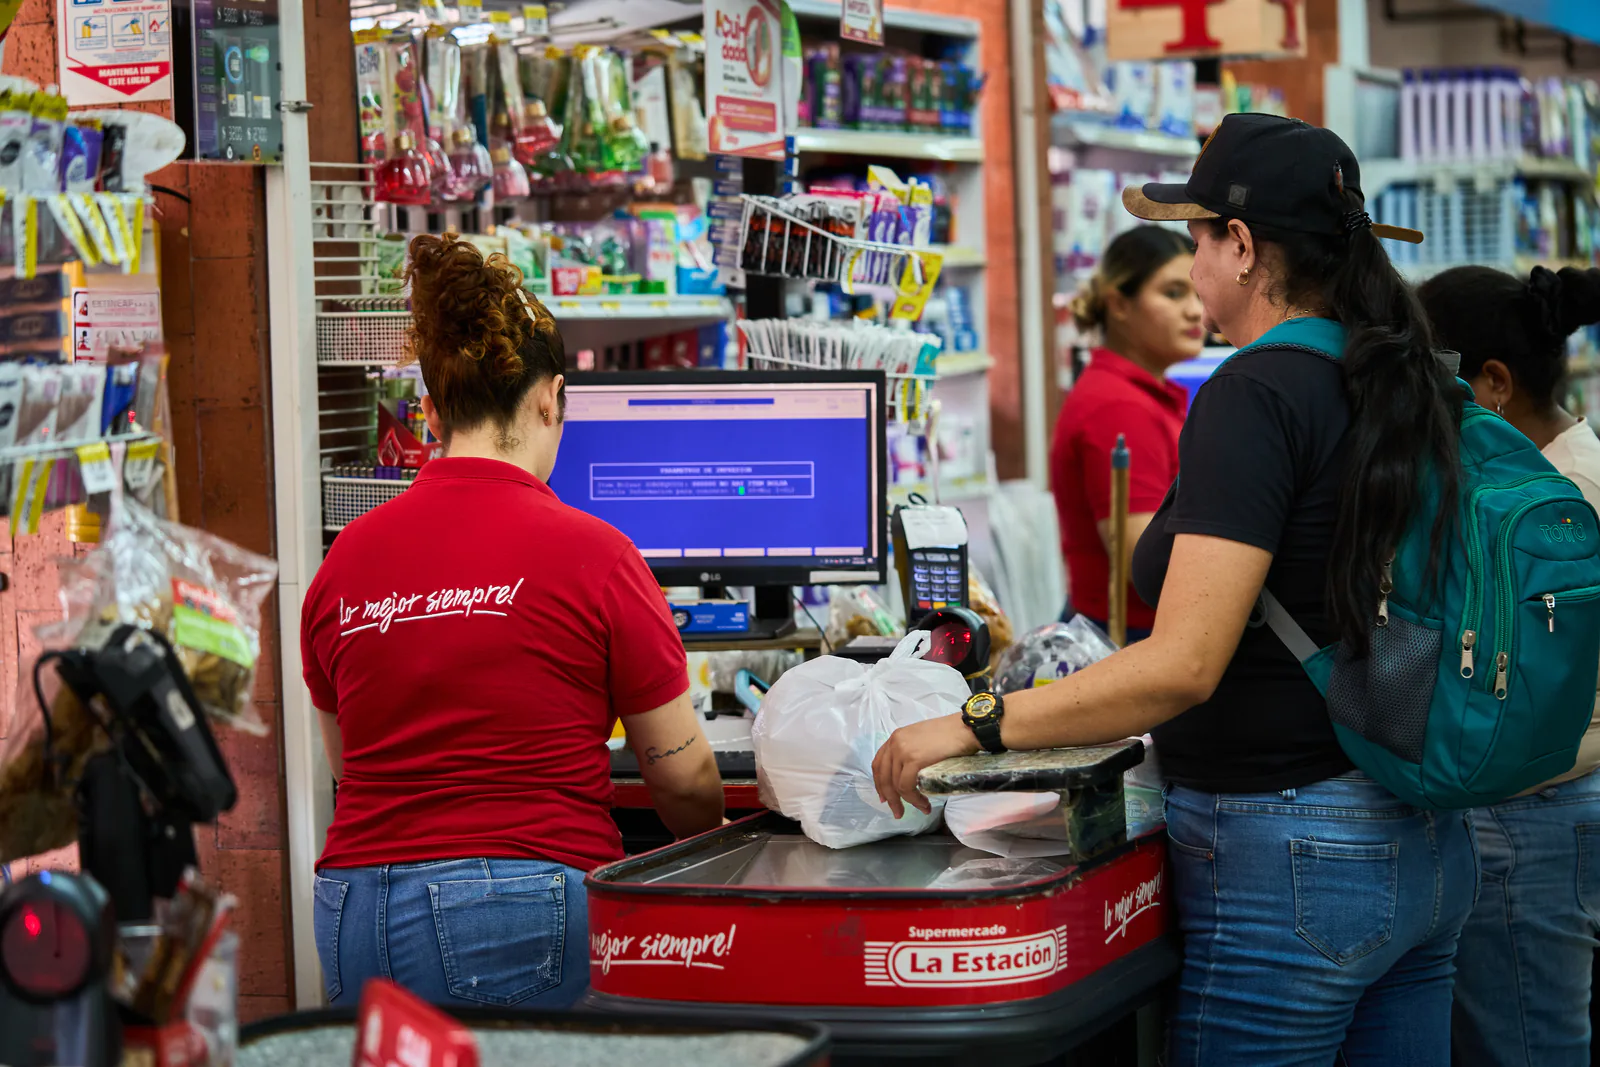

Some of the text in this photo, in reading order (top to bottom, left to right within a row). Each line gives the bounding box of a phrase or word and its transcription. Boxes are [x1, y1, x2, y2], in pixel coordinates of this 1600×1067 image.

[98, 67, 139, 78] MANTENGA
[108, 75, 151, 87] ESTE LUGAR
[1540, 520, 1586, 543] TOTTO
[362, 592, 423, 634] mejor
[426, 577, 525, 617] siempre!
[1115, 890, 1135, 938] mejor
[908, 924, 1007, 940] Supermercado
[639, 923, 737, 969] siempre!
[910, 944, 1052, 974] La Estación
